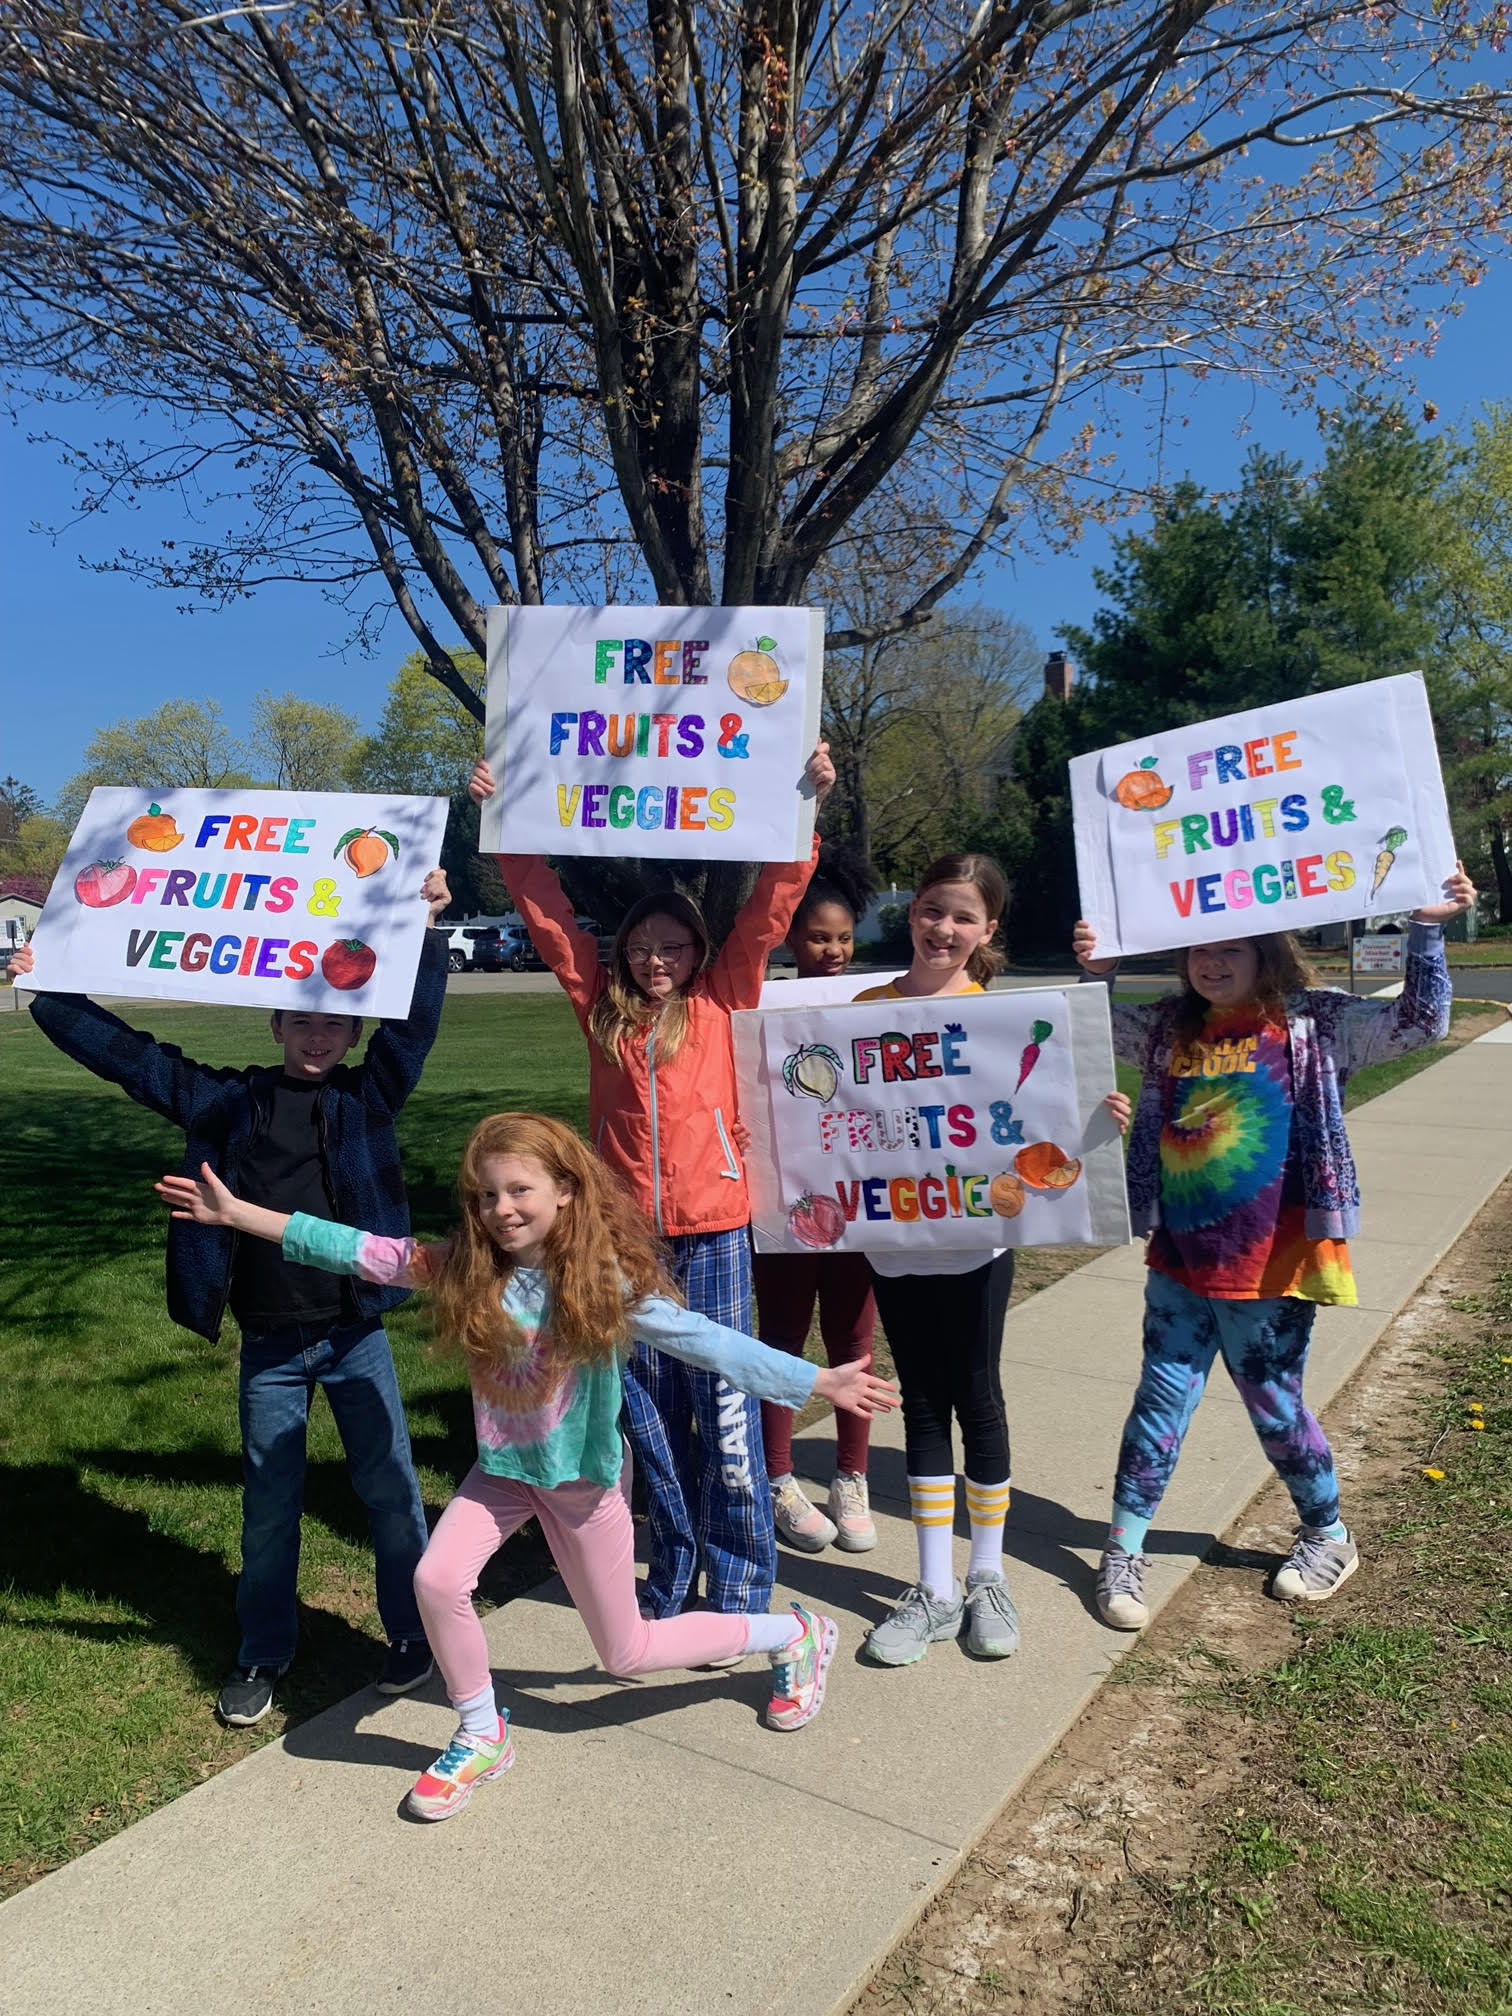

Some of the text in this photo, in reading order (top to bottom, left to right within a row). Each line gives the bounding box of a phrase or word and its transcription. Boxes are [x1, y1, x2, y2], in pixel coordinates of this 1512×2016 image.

[595, 639, 709, 685] FREE
[549, 710, 750, 759] FRUITS &
[1187, 730, 1302, 790] FREE
[557, 784, 736, 831] VEGGIES
[1152, 784, 1358, 860] FRUITS &
[194, 815, 317, 854] FREE
[130, 869, 342, 918] FRUITS &
[1169, 850, 1356, 918] VEGGIES
[126, 929, 319, 979] VEGGIES
[852, 1031, 971, 1084] FREE
[818, 1100, 1026, 1154] FRUITS &
[834, 1173, 1026, 1222] VEGGIES
